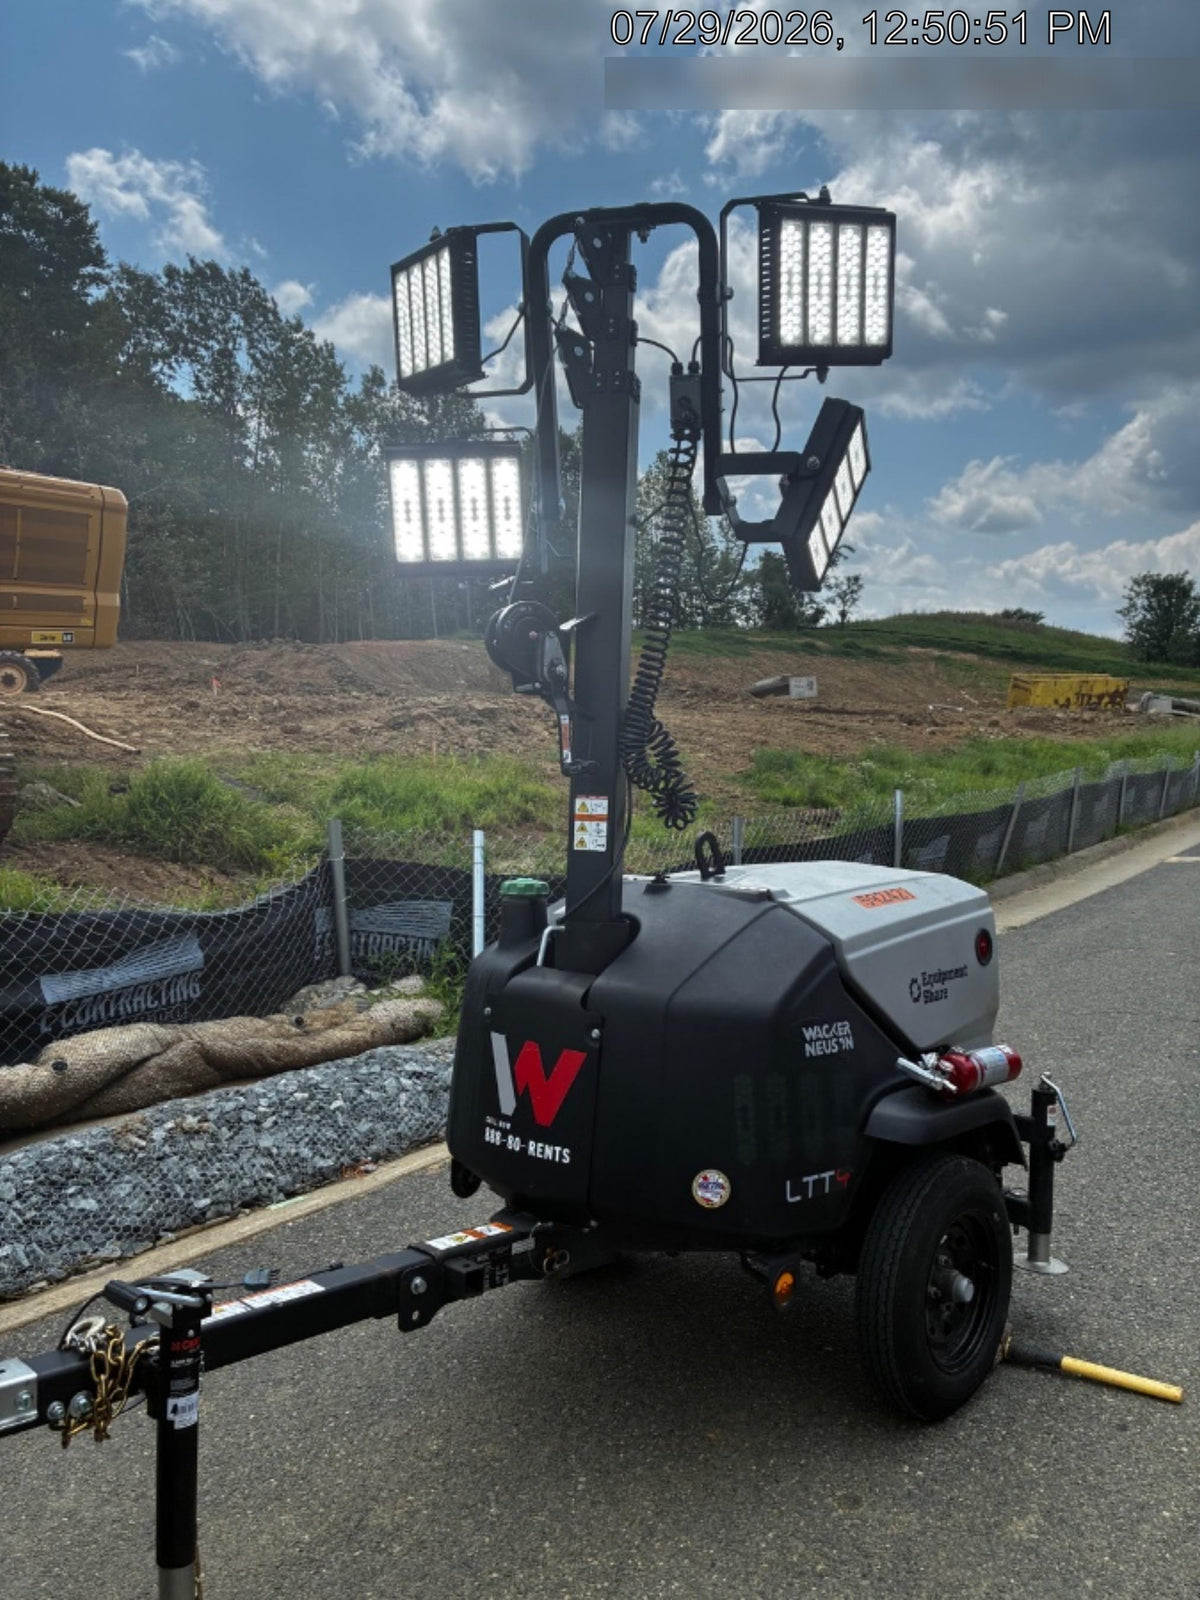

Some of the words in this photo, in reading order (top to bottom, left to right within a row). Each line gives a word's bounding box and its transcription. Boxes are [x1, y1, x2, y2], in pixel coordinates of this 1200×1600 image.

[923, 988, 948, 1004] Share
[801, 1020, 852, 1041] WACKER
[484, 1127, 571, 1164] 888-80-RENTS
